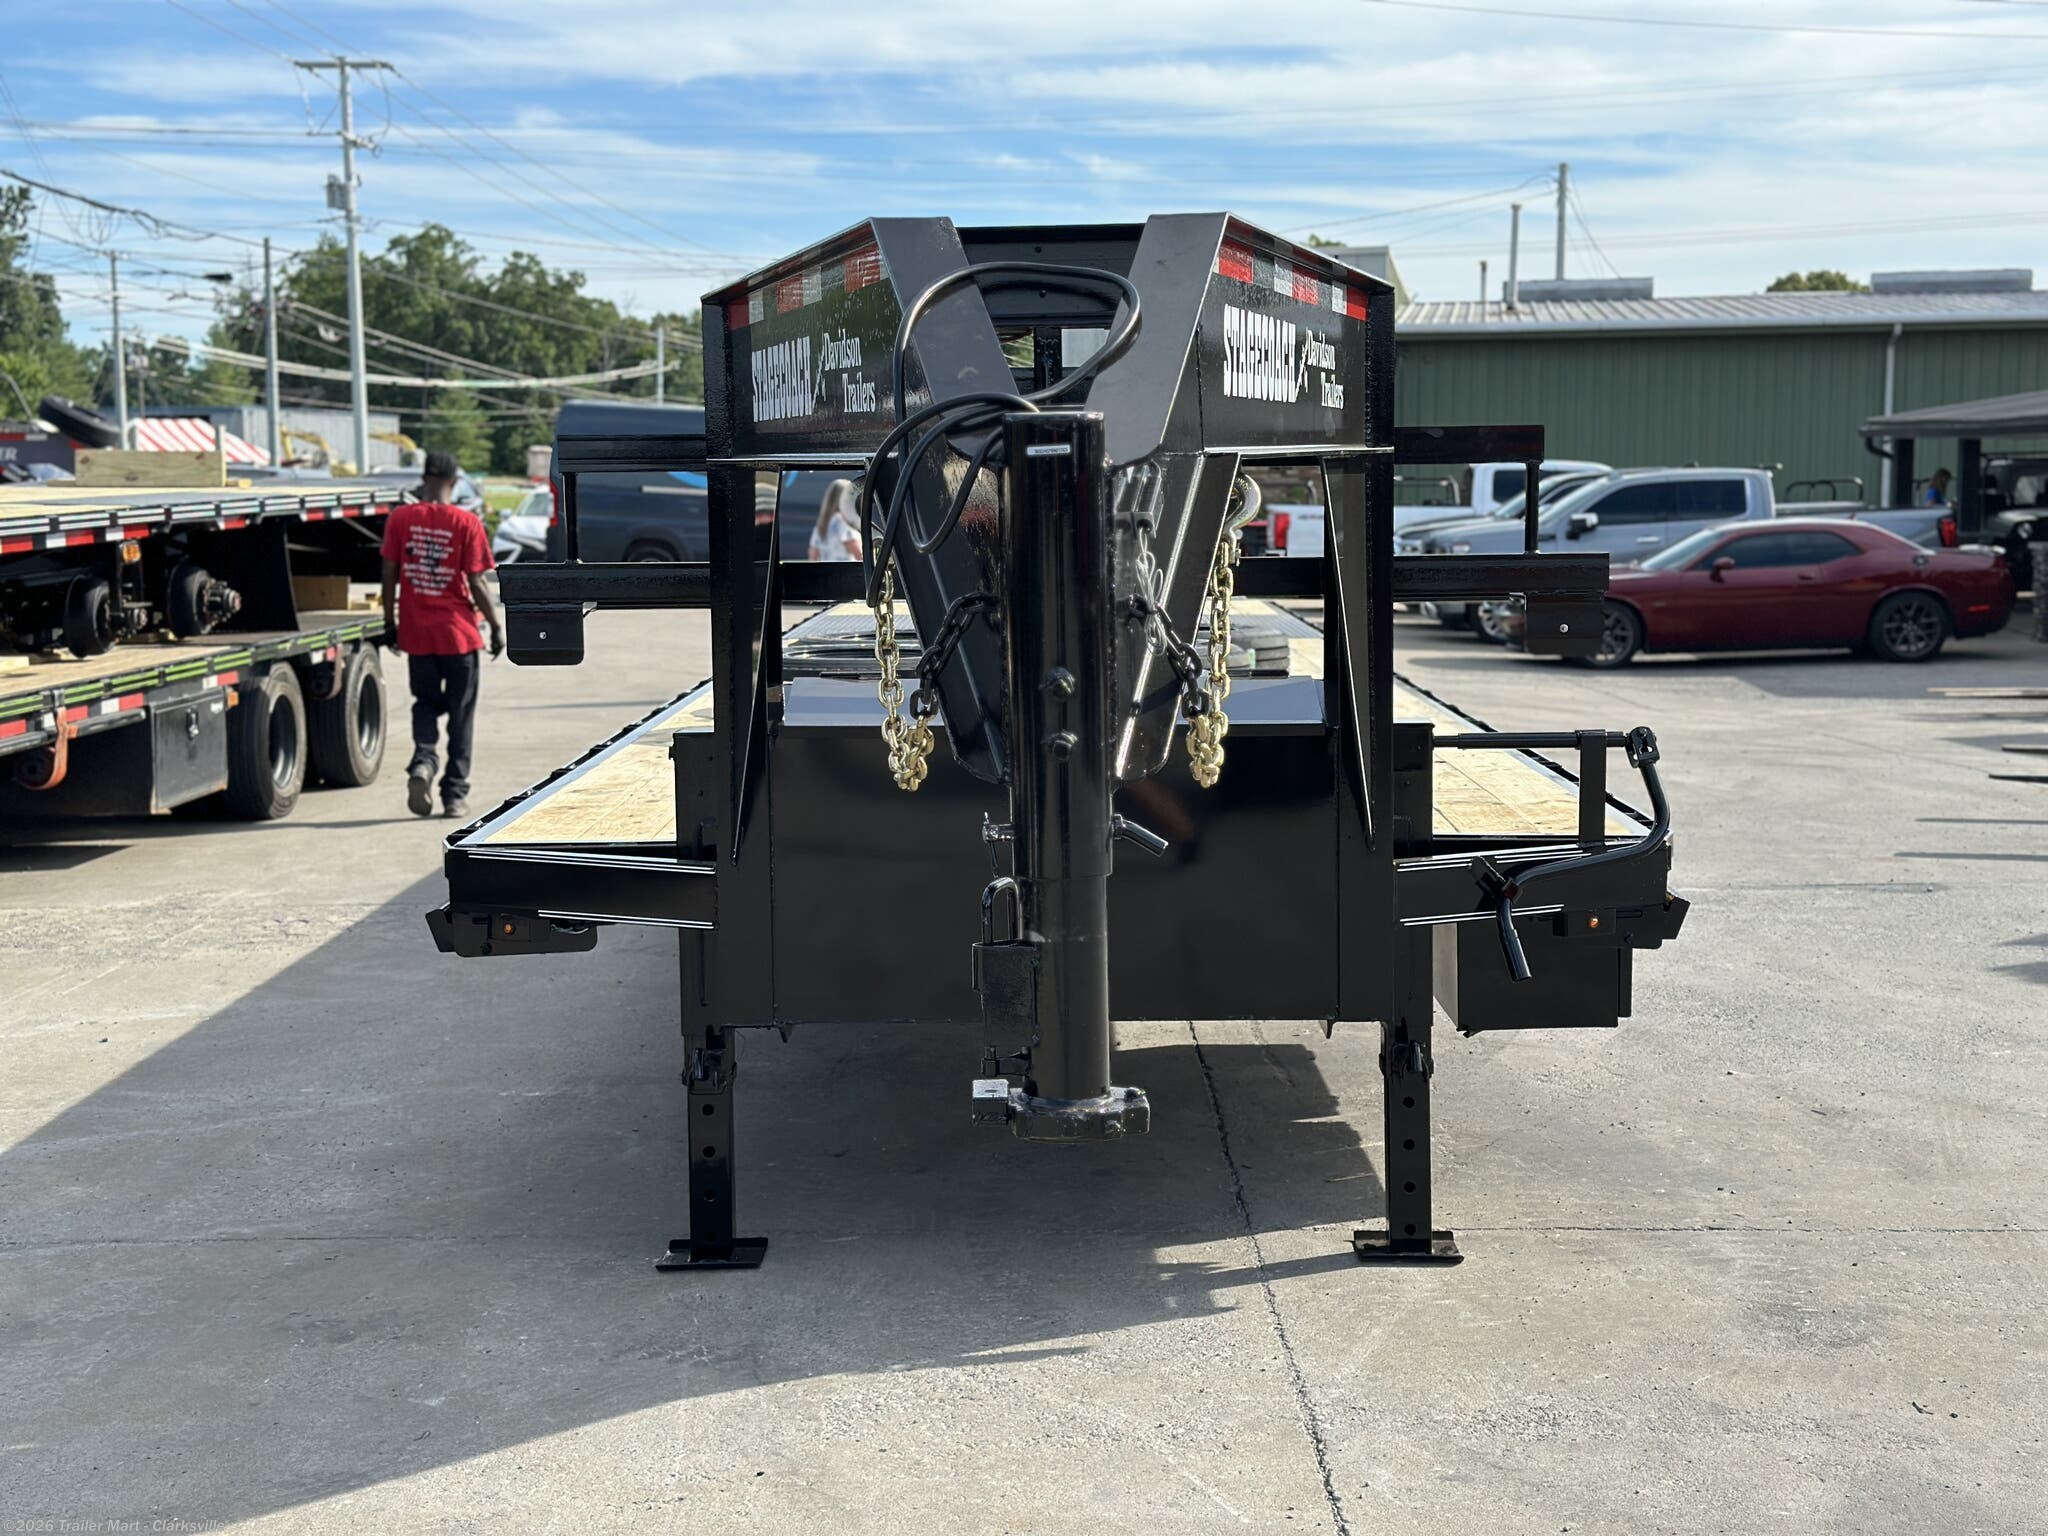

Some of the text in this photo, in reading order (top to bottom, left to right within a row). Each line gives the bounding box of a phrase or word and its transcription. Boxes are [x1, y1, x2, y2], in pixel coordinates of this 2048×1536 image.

[823, 329, 862, 371] Davidson
[1223, 303, 1297, 403] STAGECOACH
[1307, 328, 1336, 371] Davidson
[752, 335, 812, 423] STAGECOACH
[842, 371, 876, 413] Trailers
[1320, 371, 1344, 410] Trailers
